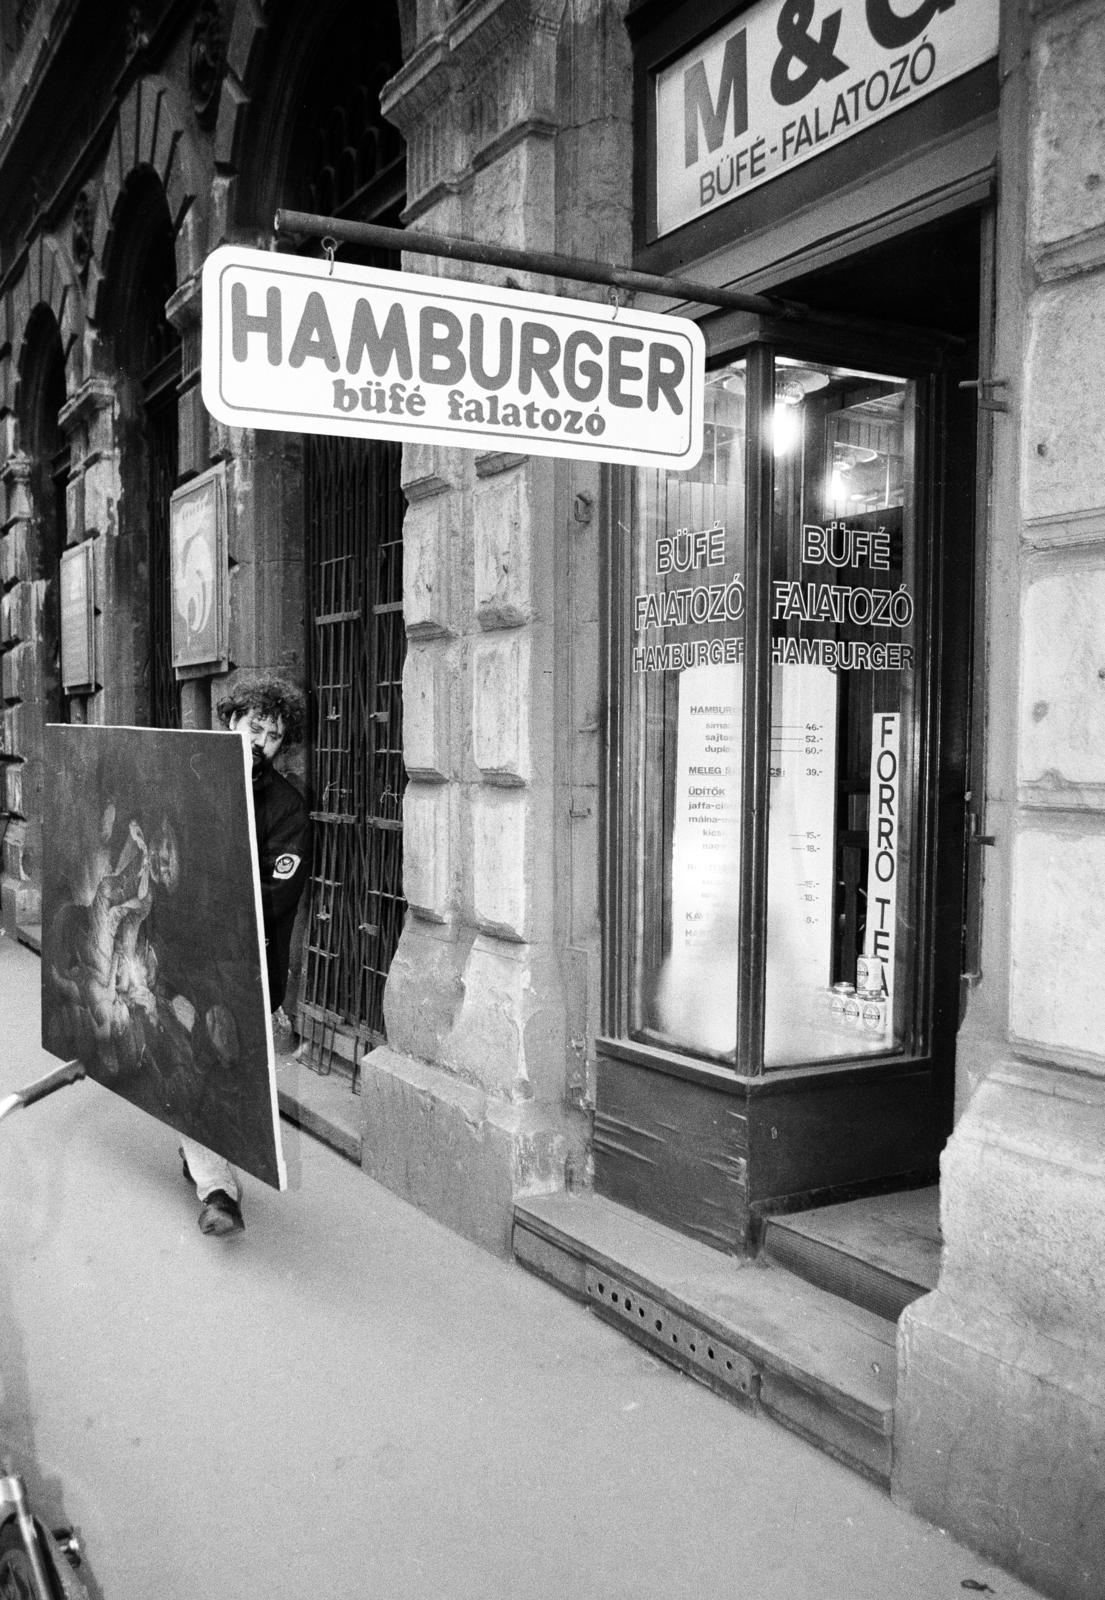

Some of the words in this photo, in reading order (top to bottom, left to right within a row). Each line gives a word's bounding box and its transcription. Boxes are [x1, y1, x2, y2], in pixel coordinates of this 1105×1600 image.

[684, 27, 749, 169] M
[231, 282, 686, 416] HAMBURGER
[332, 379, 427, 417] büfé
[448, 389, 606, 437] falatozó
[655, 520, 725, 575] BÜFÉ
[802, 522, 890, 570] BÜFÉ
[634, 573, 744, 631] FALATOZÓ
[772, 580, 914, 628] FALATOZÓ
[689, 766, 722, 775] MELEG
[876, 716, 897, 882] FORRÓ
